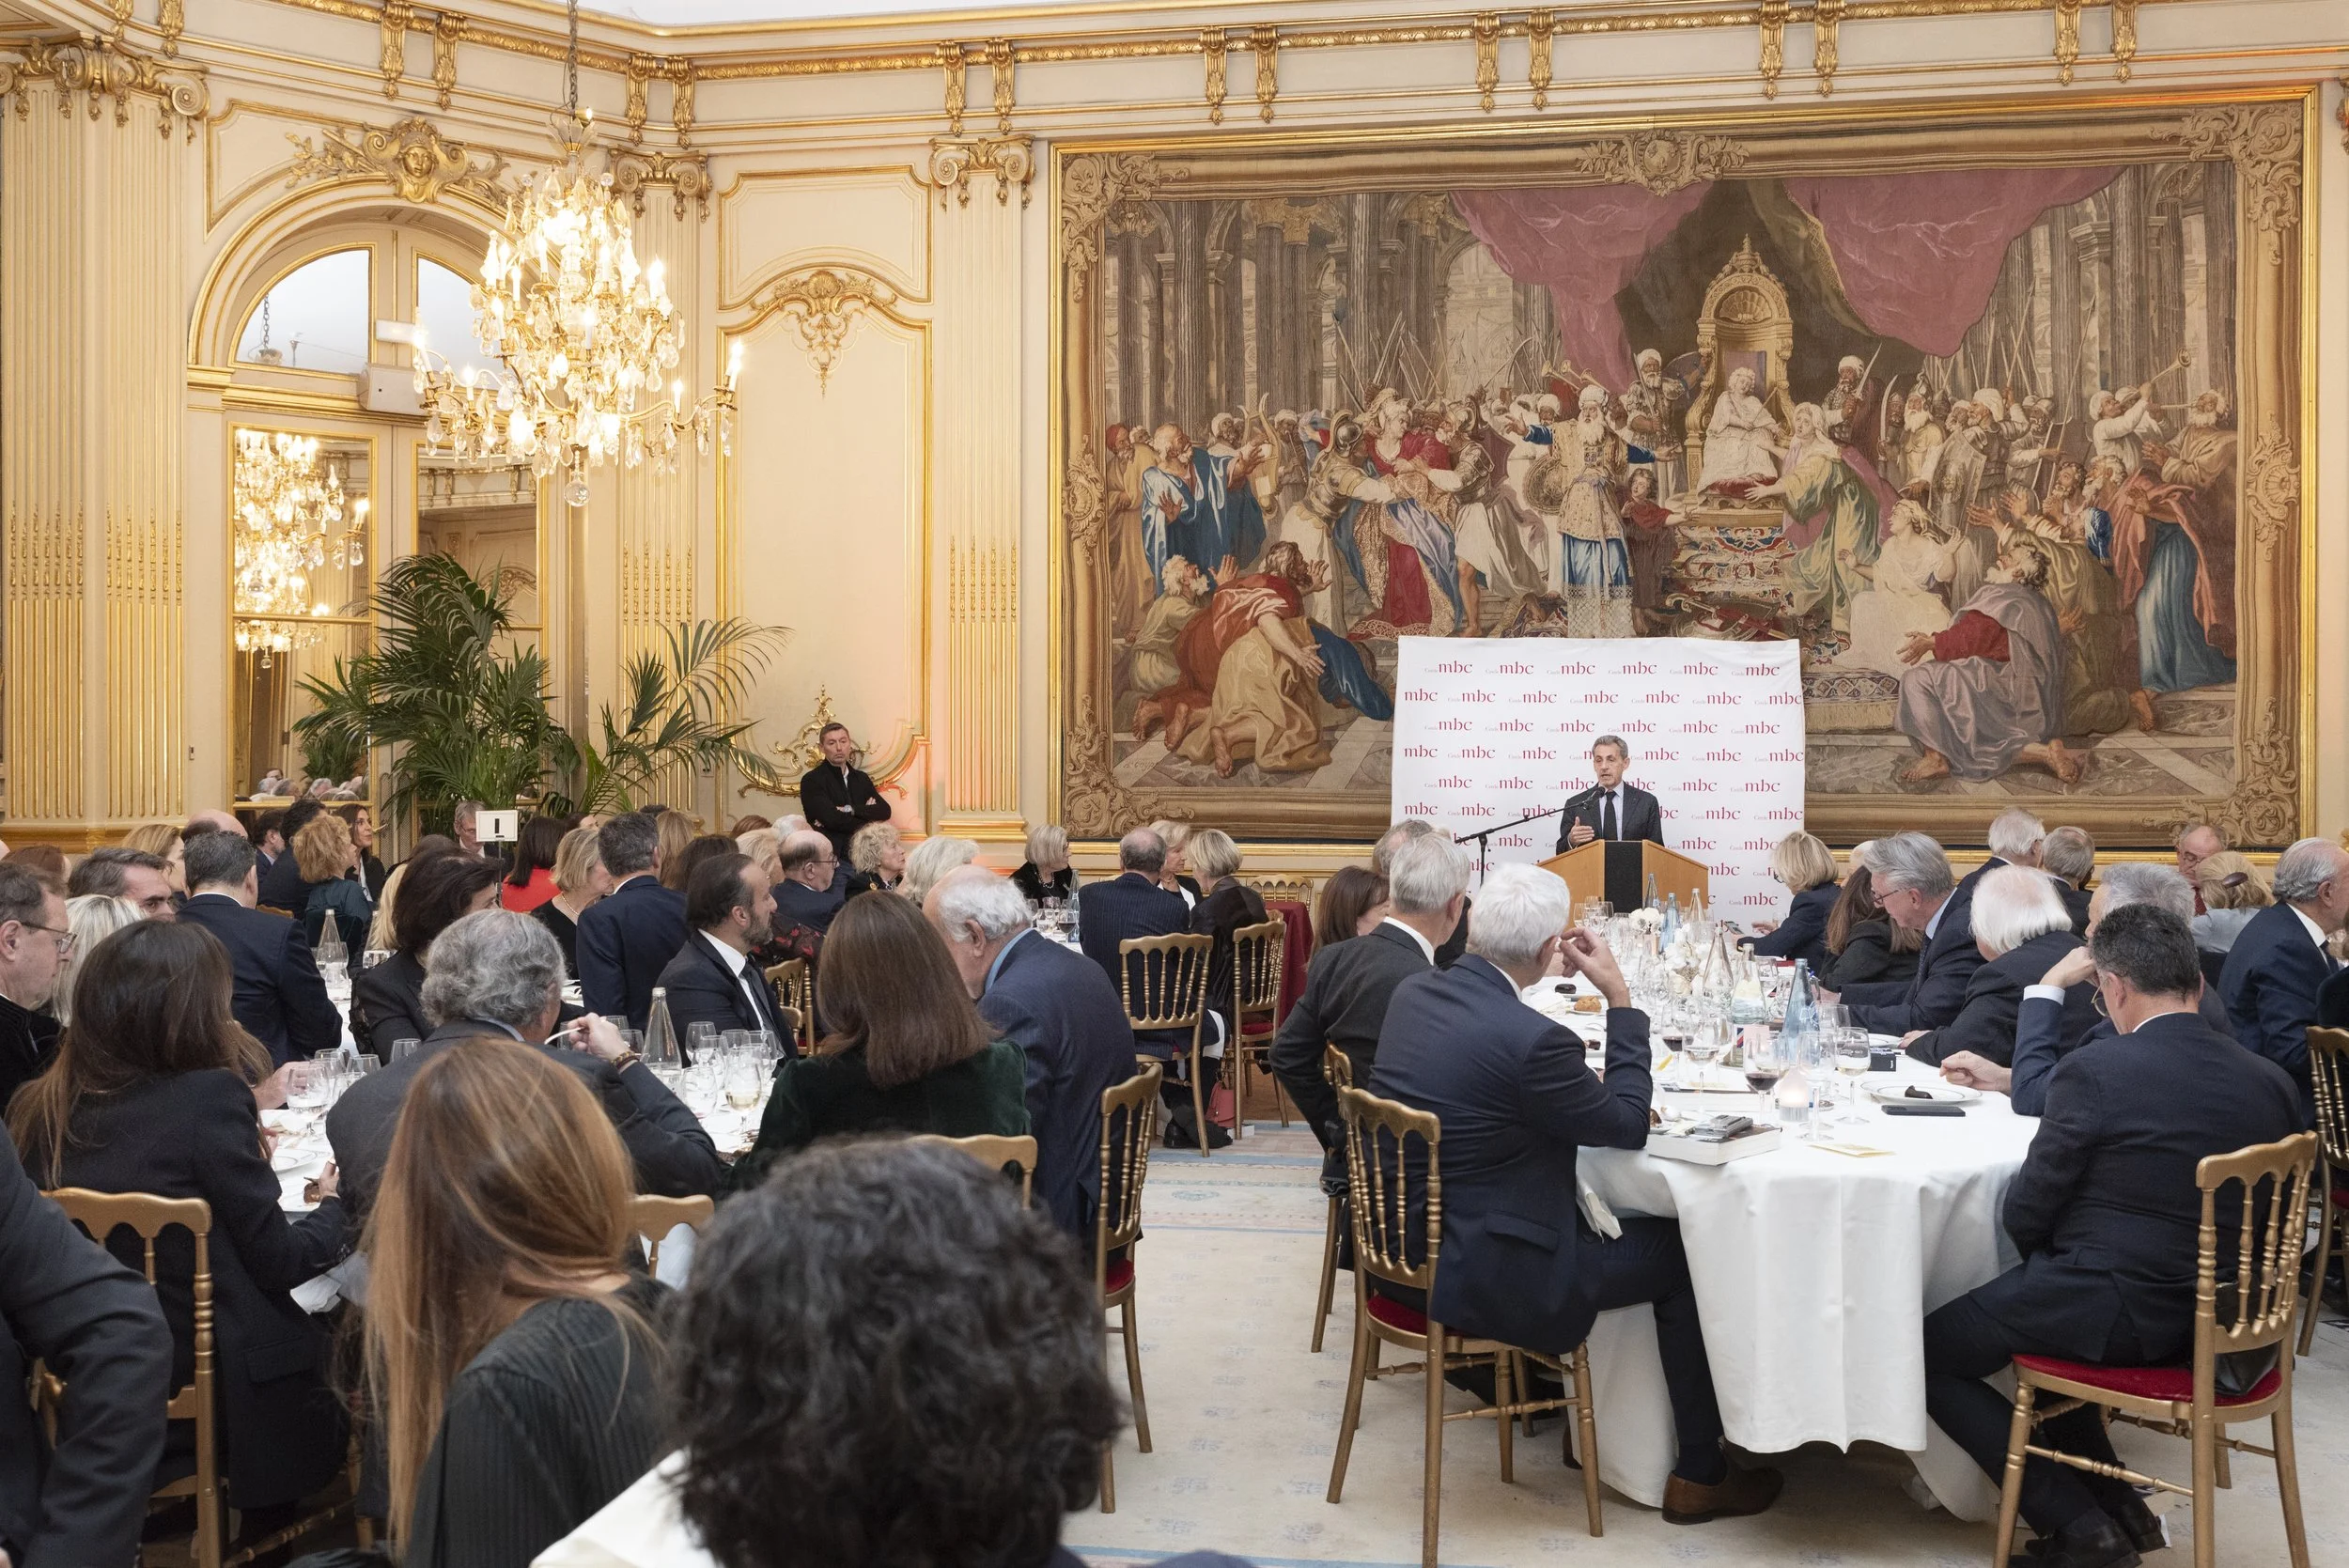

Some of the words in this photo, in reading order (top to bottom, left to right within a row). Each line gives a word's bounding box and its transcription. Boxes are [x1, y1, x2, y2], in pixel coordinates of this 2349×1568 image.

[1439, 660, 1472, 674] mbc
[1500, 661, 1534, 675] mbc
[1561, 661, 1595, 675] mbc
[1623, 661, 1657, 675] mbc
[1684, 662, 1719, 675] mbc
[1745, 663, 1780, 676] mbc
[1404, 688, 1438, 702] mbc
[1462, 689, 1496, 703] mbc
[1522, 690, 1557, 703] mbc
[1584, 691, 1618, 704] mbc
[1645, 691, 1680, 704] mbc
[1707, 691, 1741, 705] mbc
[1768, 691, 1802, 705] mbc
[1439, 717, 1472, 731] mbc
[1499, 719, 1533, 732] mbc
[1560, 719, 1595, 732] mbc
[1622, 719, 1656, 733] mbc
[1683, 720, 1718, 734] mbc
[1745, 721, 1780, 734] mbc
[1404, 744, 1438, 758] mbc
[1462, 746, 1496, 759] mbc
[1522, 747, 1557, 760] mbc
[1645, 747, 1679, 761] mbc
[1706, 748, 1741, 762] mbc
[1769, 748, 1804, 762] mbc
[1439, 775, 1472, 789] mbc
[1499, 776, 1533, 790] mbc
[1560, 777, 1595, 790] mbc
[1683, 778, 1718, 792] mbc
[1745, 779, 1781, 792] mbc
[1404, 801, 1438, 815] mbc
[1461, 802, 1496, 816] mbc
[1706, 806, 1741, 820] mbc
[1768, 807, 1803, 820] mbc
[1499, 833, 1533, 847] mbc
[1682, 836, 1717, 849] mbc
[1744, 837, 1779, 850] mbc
[1743, 892, 1778, 906] mbc
